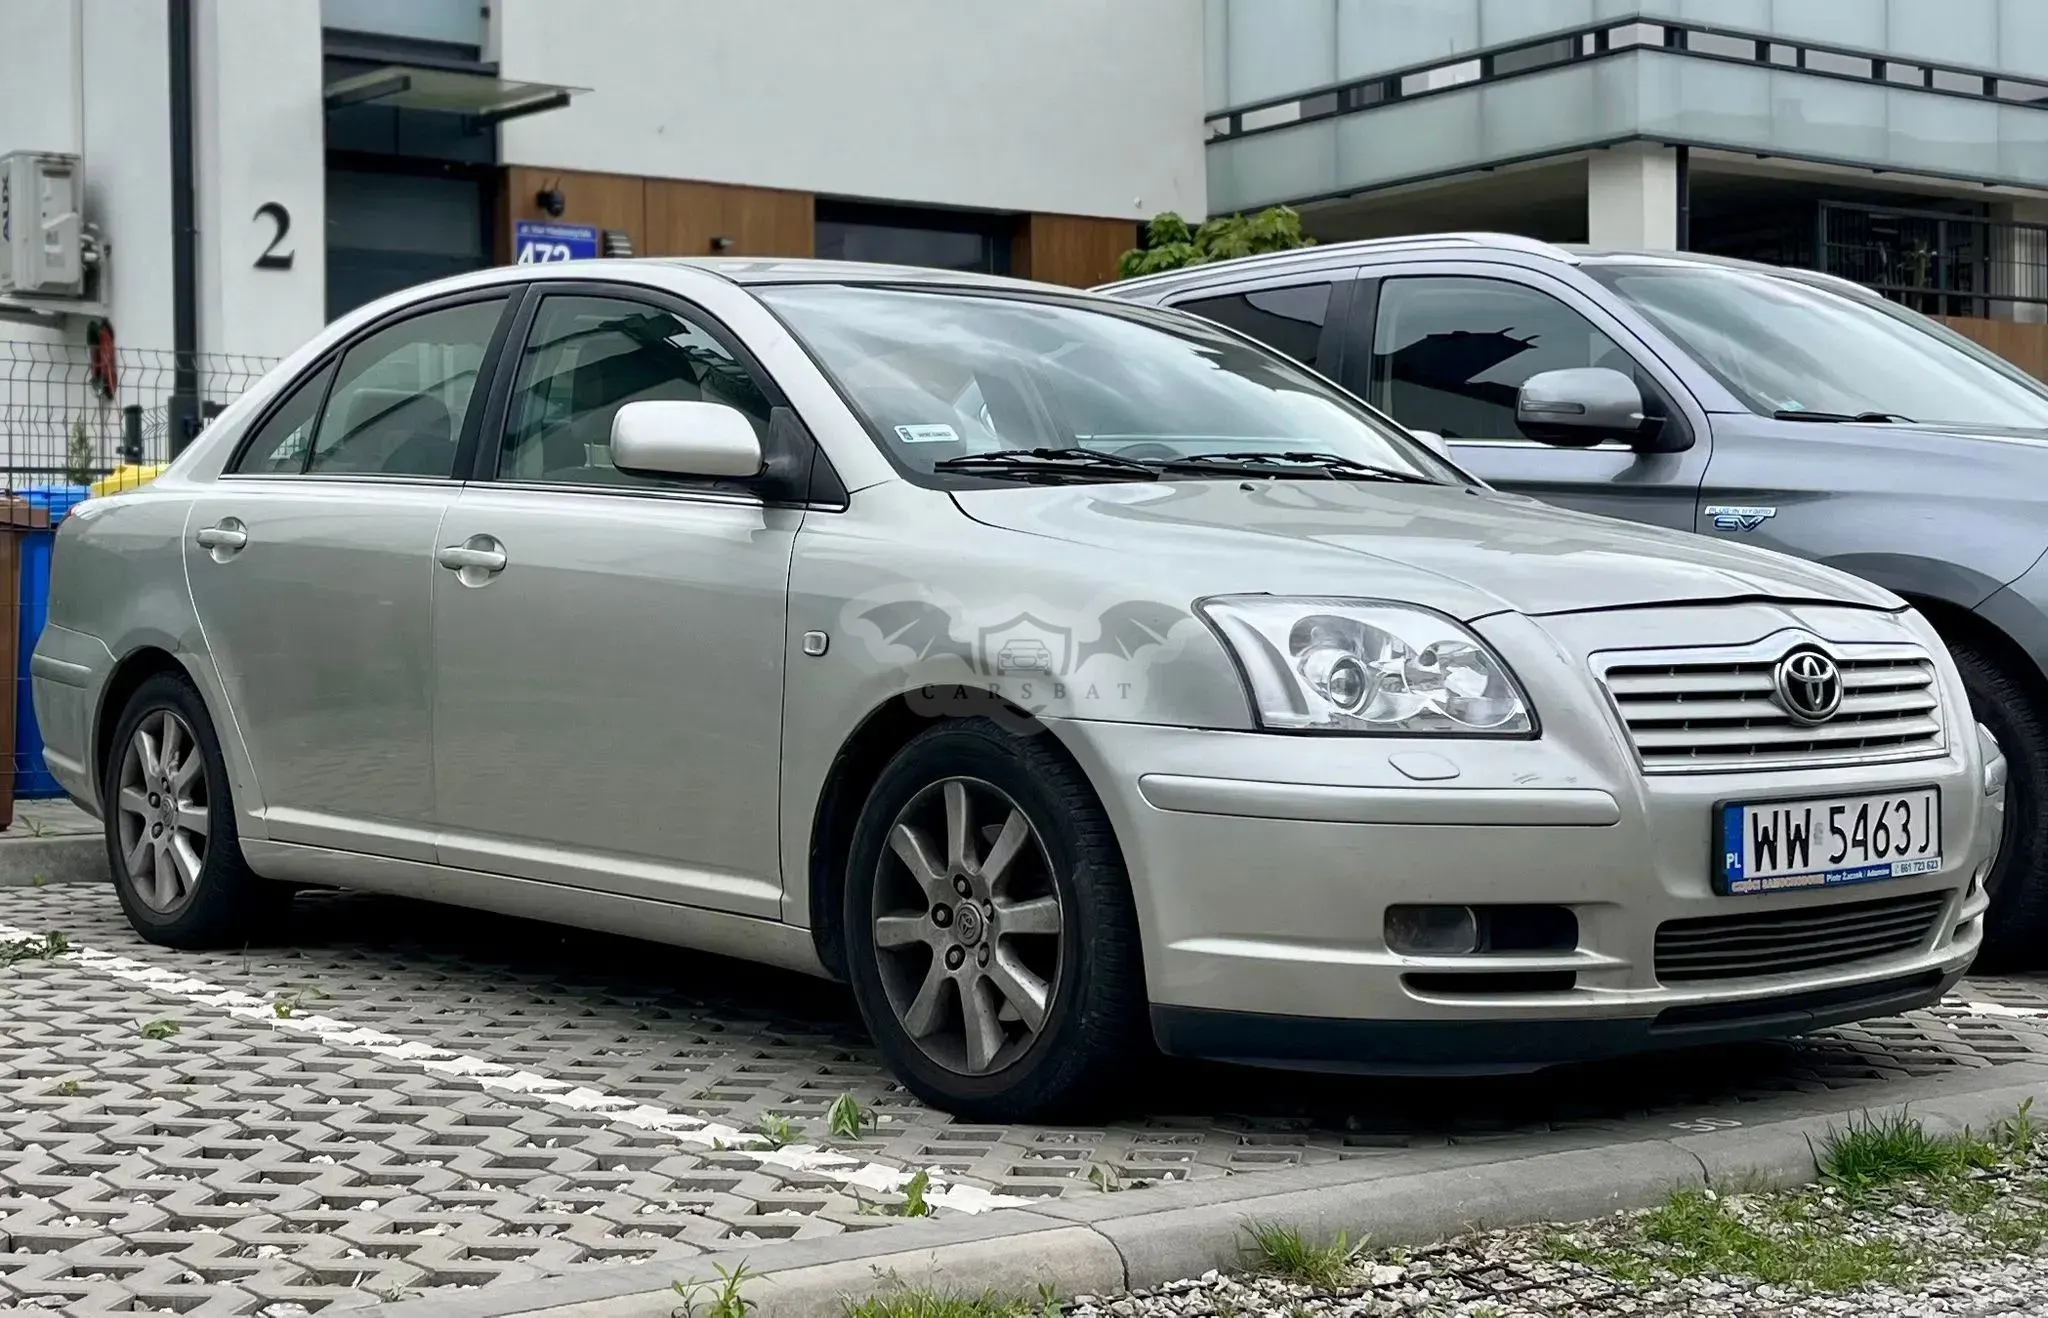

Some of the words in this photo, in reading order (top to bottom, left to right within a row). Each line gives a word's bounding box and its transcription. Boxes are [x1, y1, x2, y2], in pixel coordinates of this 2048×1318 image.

[252, 201, 296, 269] 2
[1714, 515, 1765, 531] EV
[1752, 808, 1811, 872] WW
[1829, 797, 1930, 865] 5463J
[1726, 853, 1741, 868] PL
